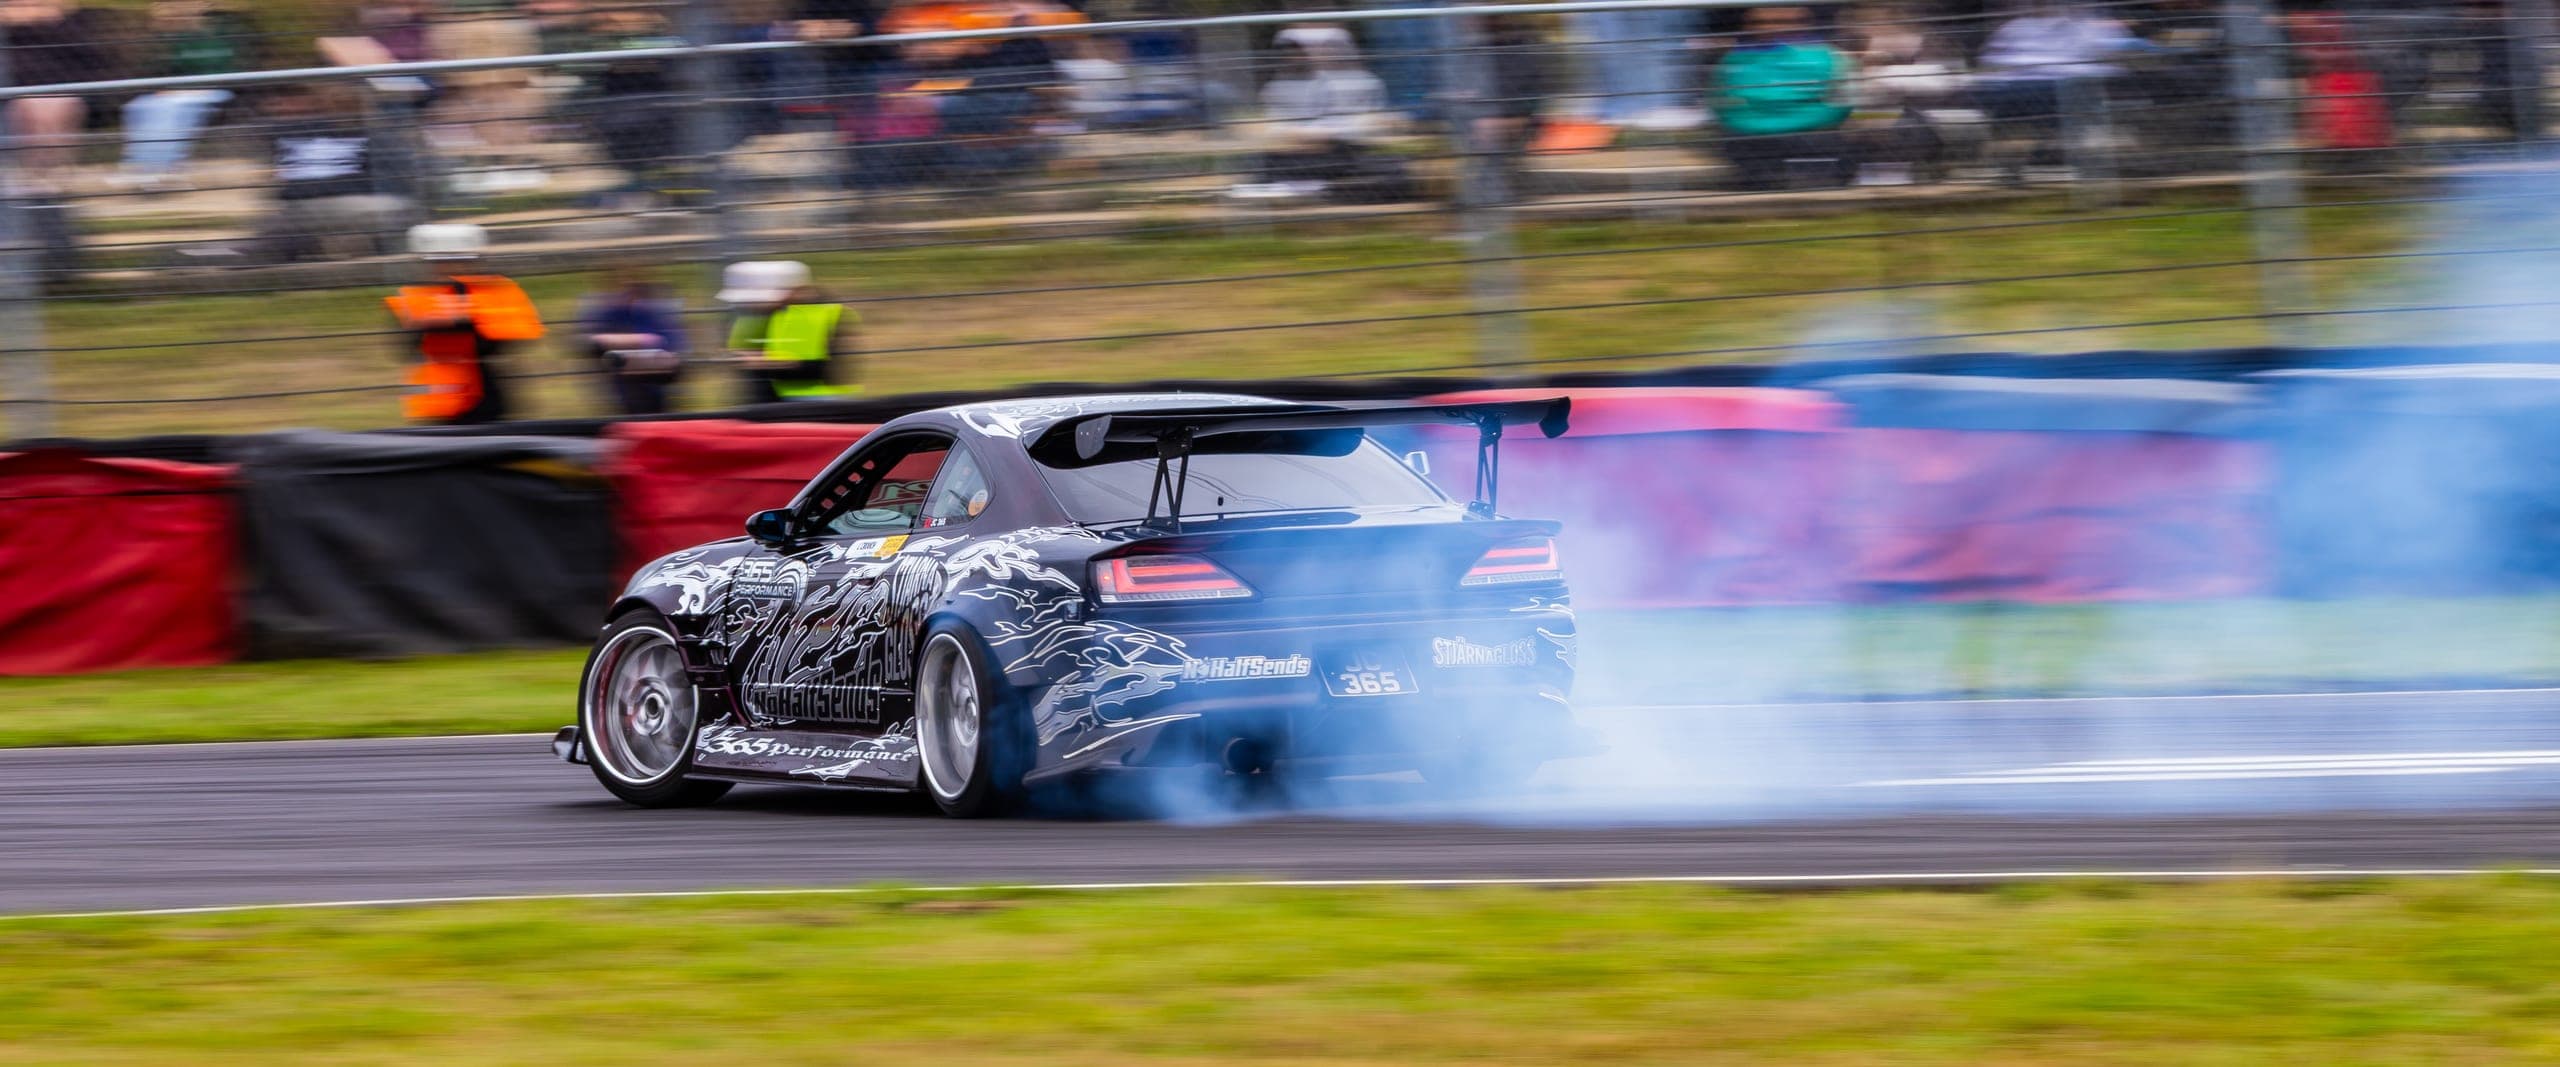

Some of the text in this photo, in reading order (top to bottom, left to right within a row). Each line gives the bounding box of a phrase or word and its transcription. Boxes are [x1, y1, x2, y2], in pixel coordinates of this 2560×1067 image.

[738, 560, 776, 583] 365
[736, 584, 793, 597] PERFORMANCE
[1340, 672, 1400, 693] 365
